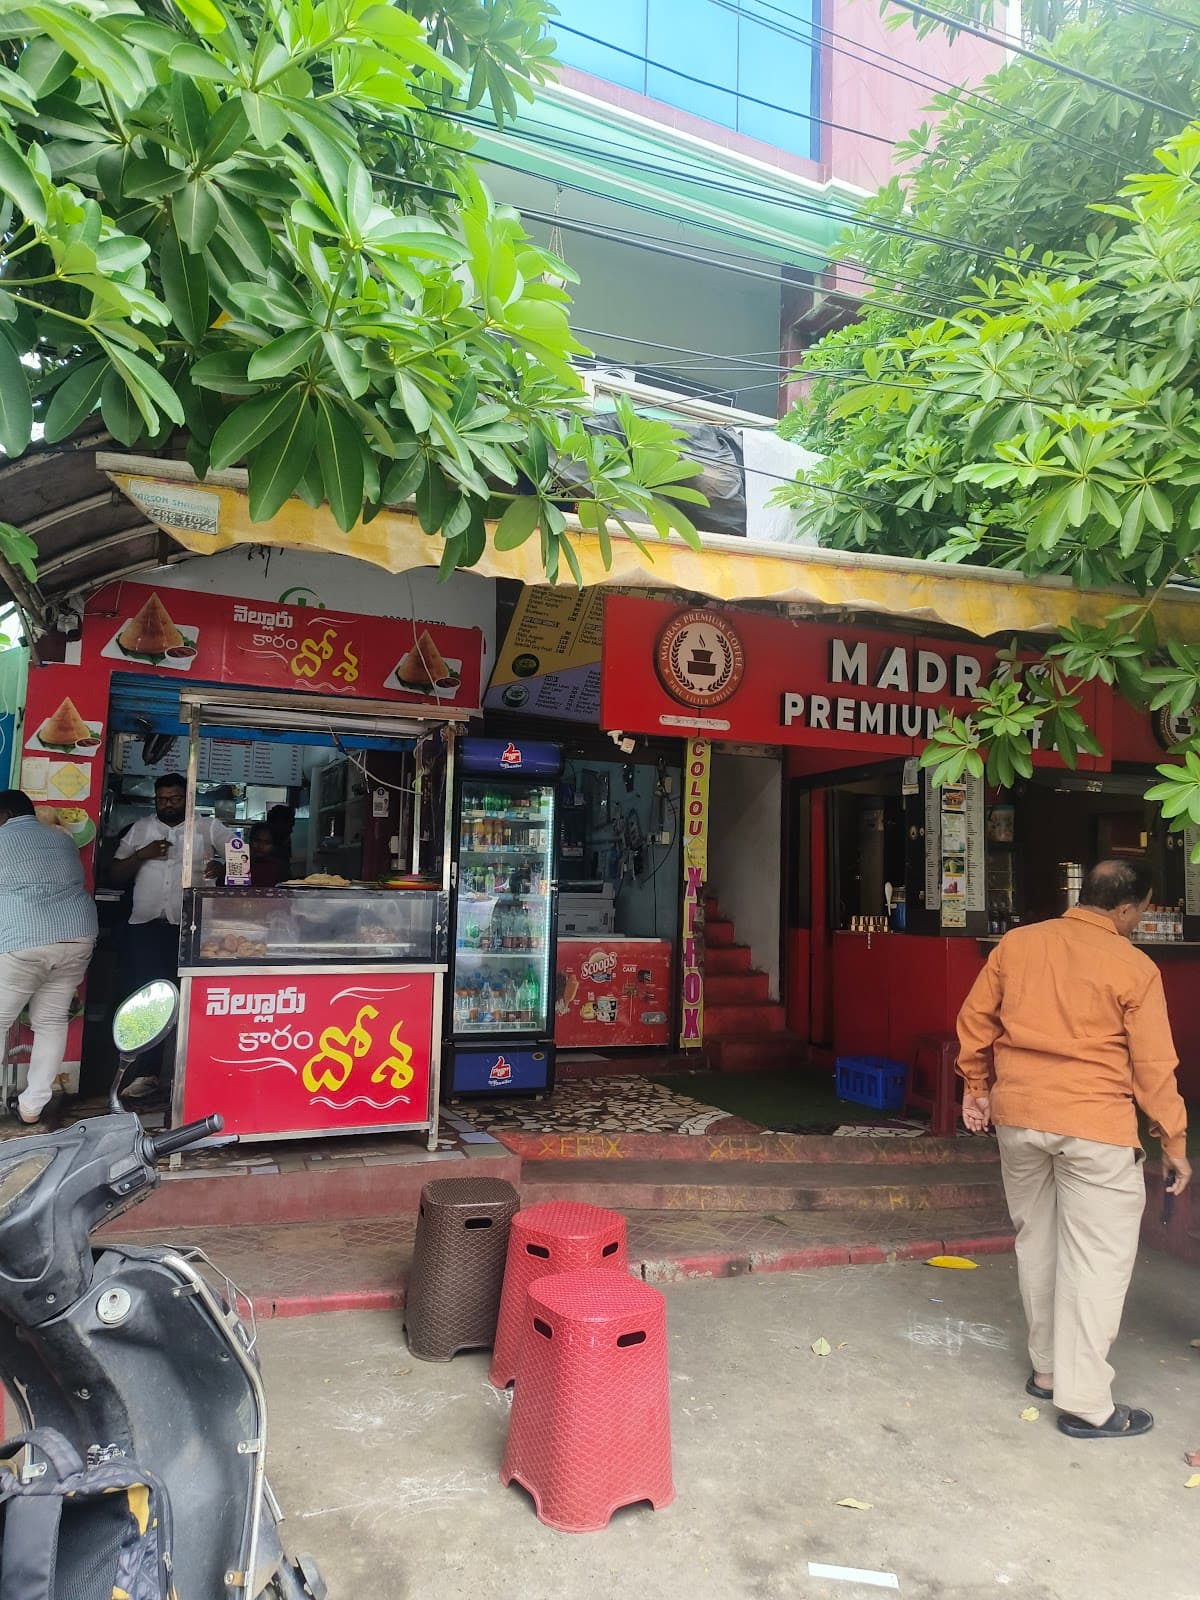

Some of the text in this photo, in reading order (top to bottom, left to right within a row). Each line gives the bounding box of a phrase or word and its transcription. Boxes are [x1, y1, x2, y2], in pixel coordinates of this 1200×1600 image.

[233, 604, 293, 631] నెల్లూరు
[252, 633, 298, 649] కారం
[661, 612, 744, 668] MADRAS PREMIUM COFFEE
[206, 986, 306, 1023] నెల్లూరు
[238, 1004, 414, 1093] కారం దోశ
[538, 1135, 624, 1159] XEROX
